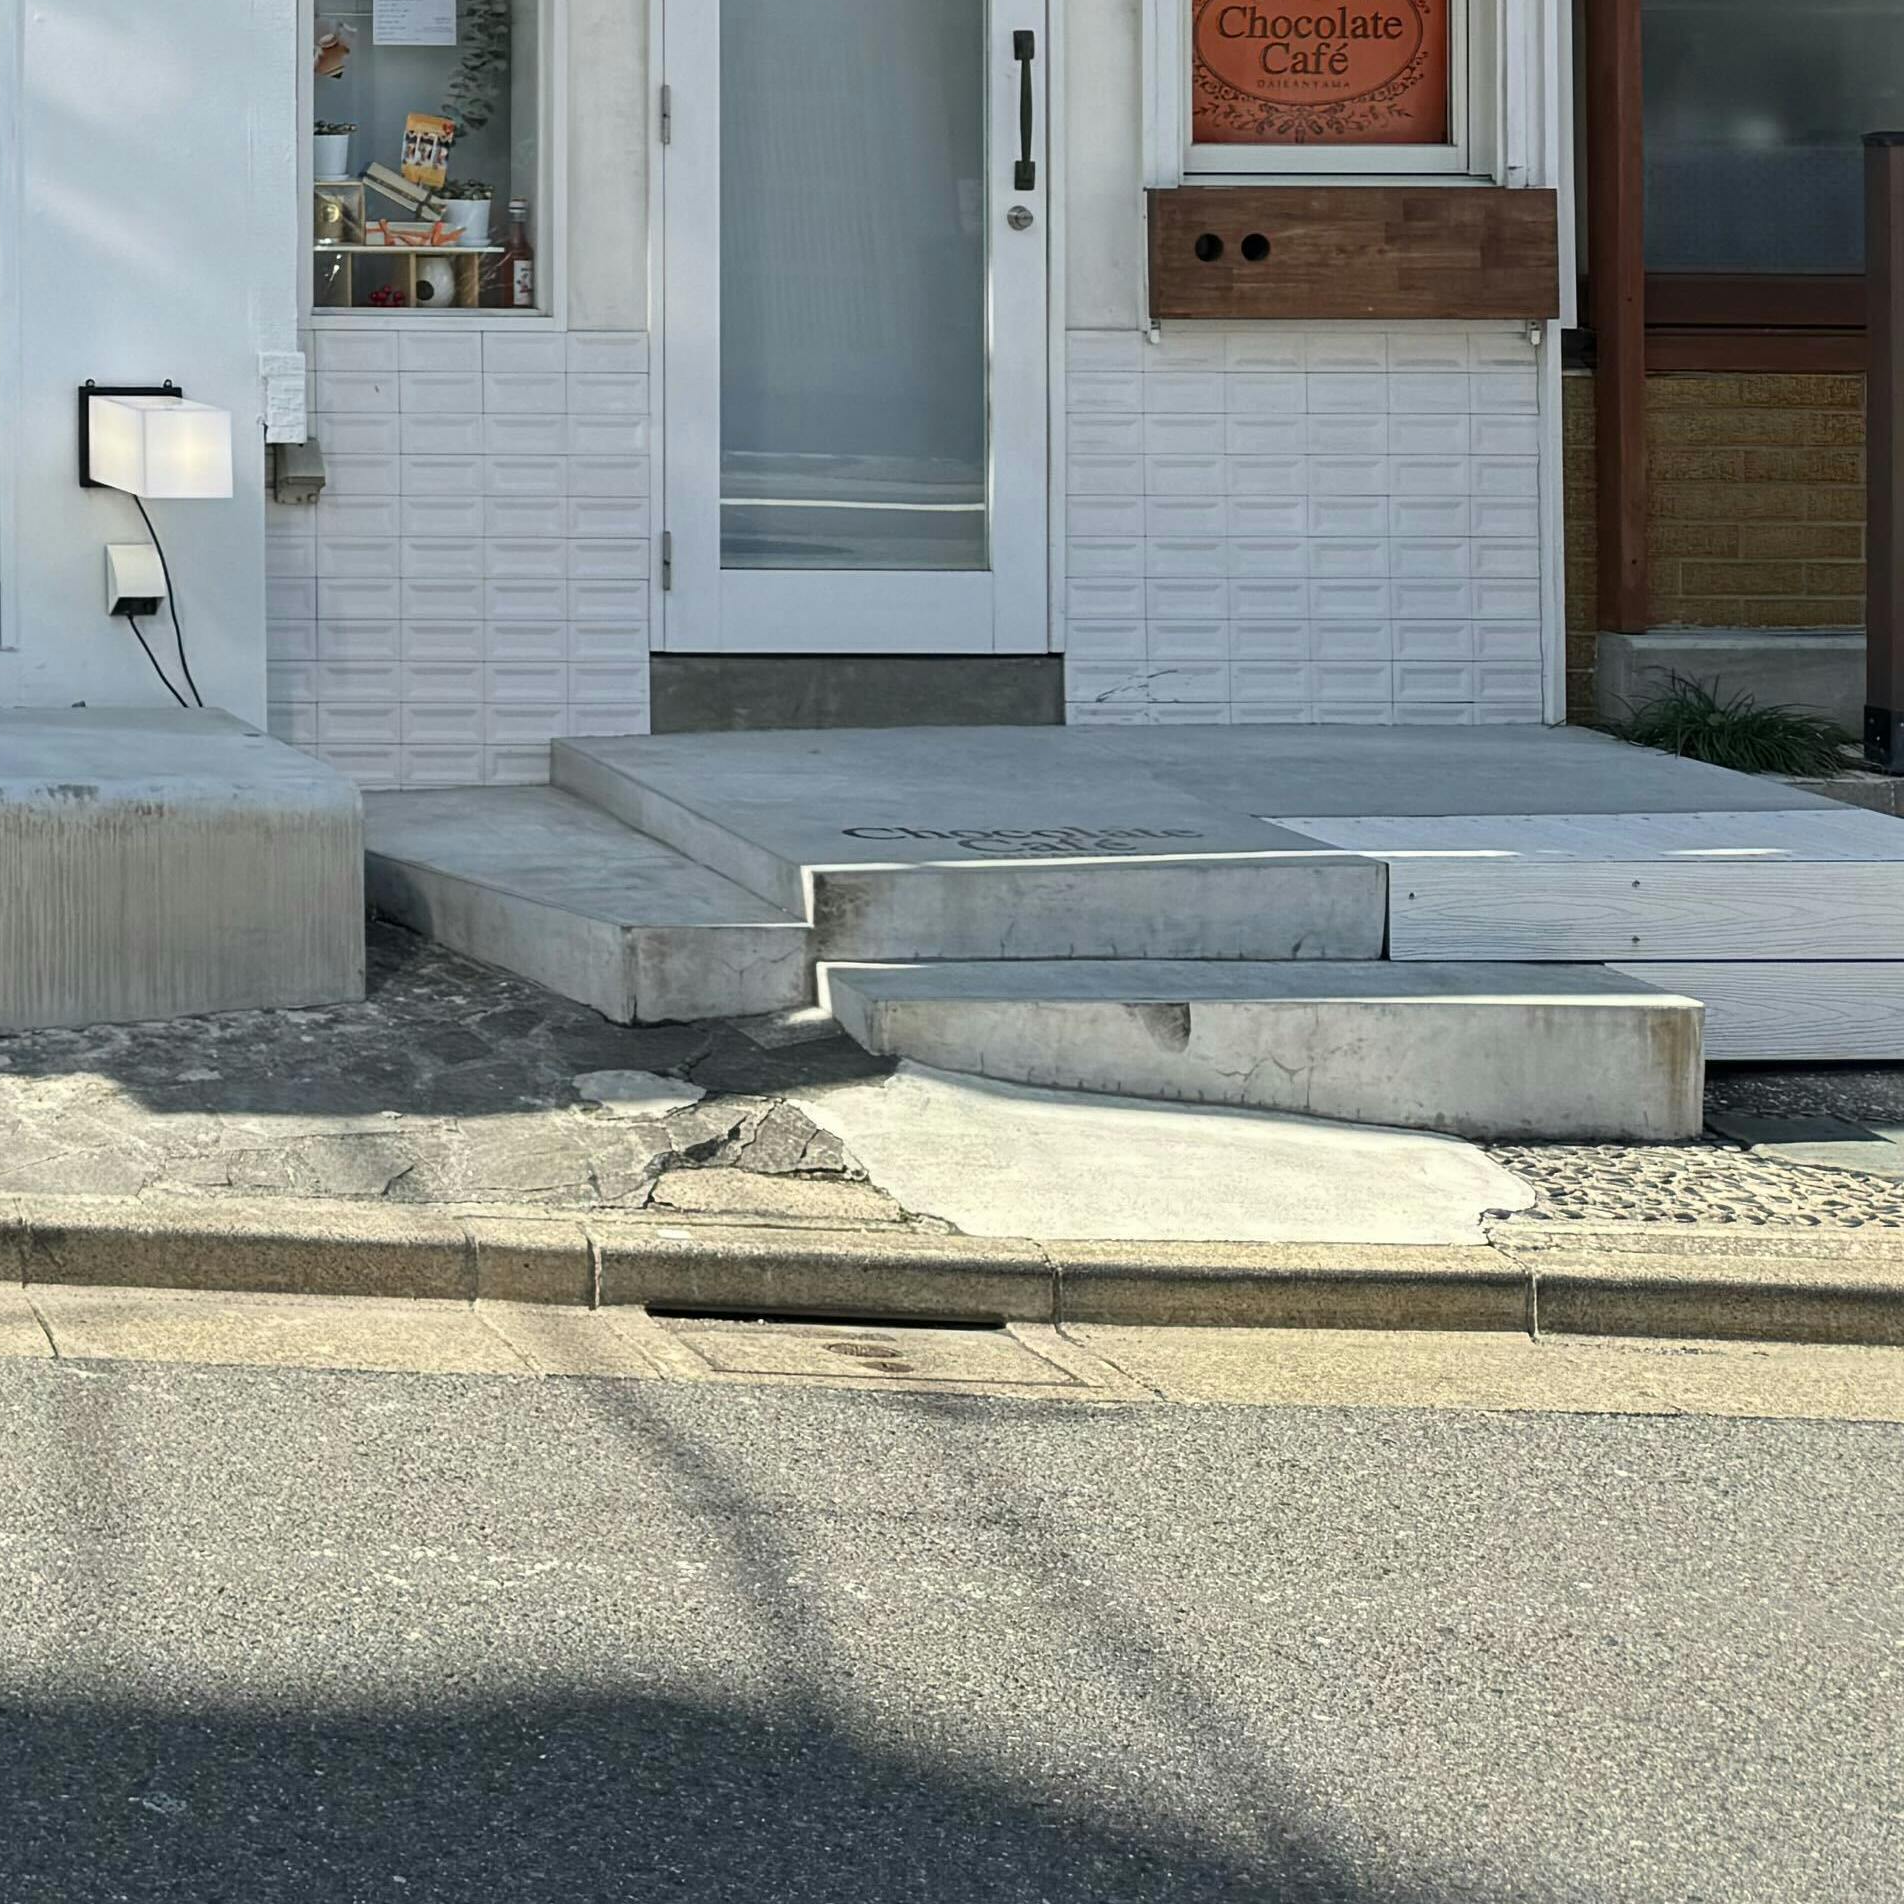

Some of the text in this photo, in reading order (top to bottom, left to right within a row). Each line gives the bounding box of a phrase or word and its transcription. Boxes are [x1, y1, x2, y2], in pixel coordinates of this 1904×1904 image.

[1218, 6, 1403, 39] Chocolate
[1261, 42, 1349, 75] Café
[841, 825, 1205, 841] Chocolate
